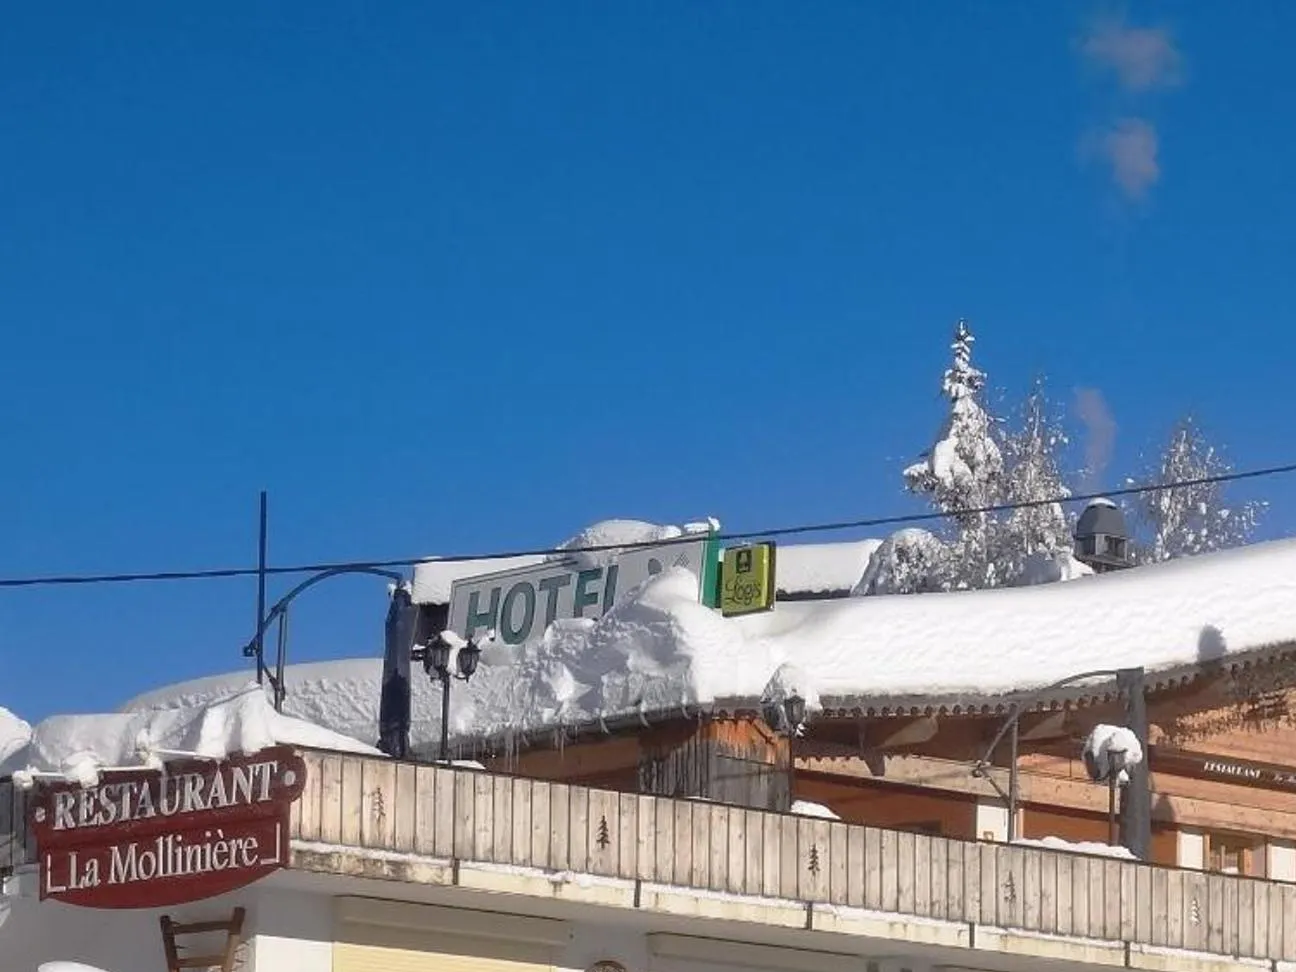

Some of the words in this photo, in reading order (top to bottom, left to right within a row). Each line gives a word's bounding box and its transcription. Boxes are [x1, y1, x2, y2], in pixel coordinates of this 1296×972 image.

[53, 760, 278, 831] RESTAURANT
[68, 850, 101, 889] La
[108, 829, 259, 885] Mollinière
